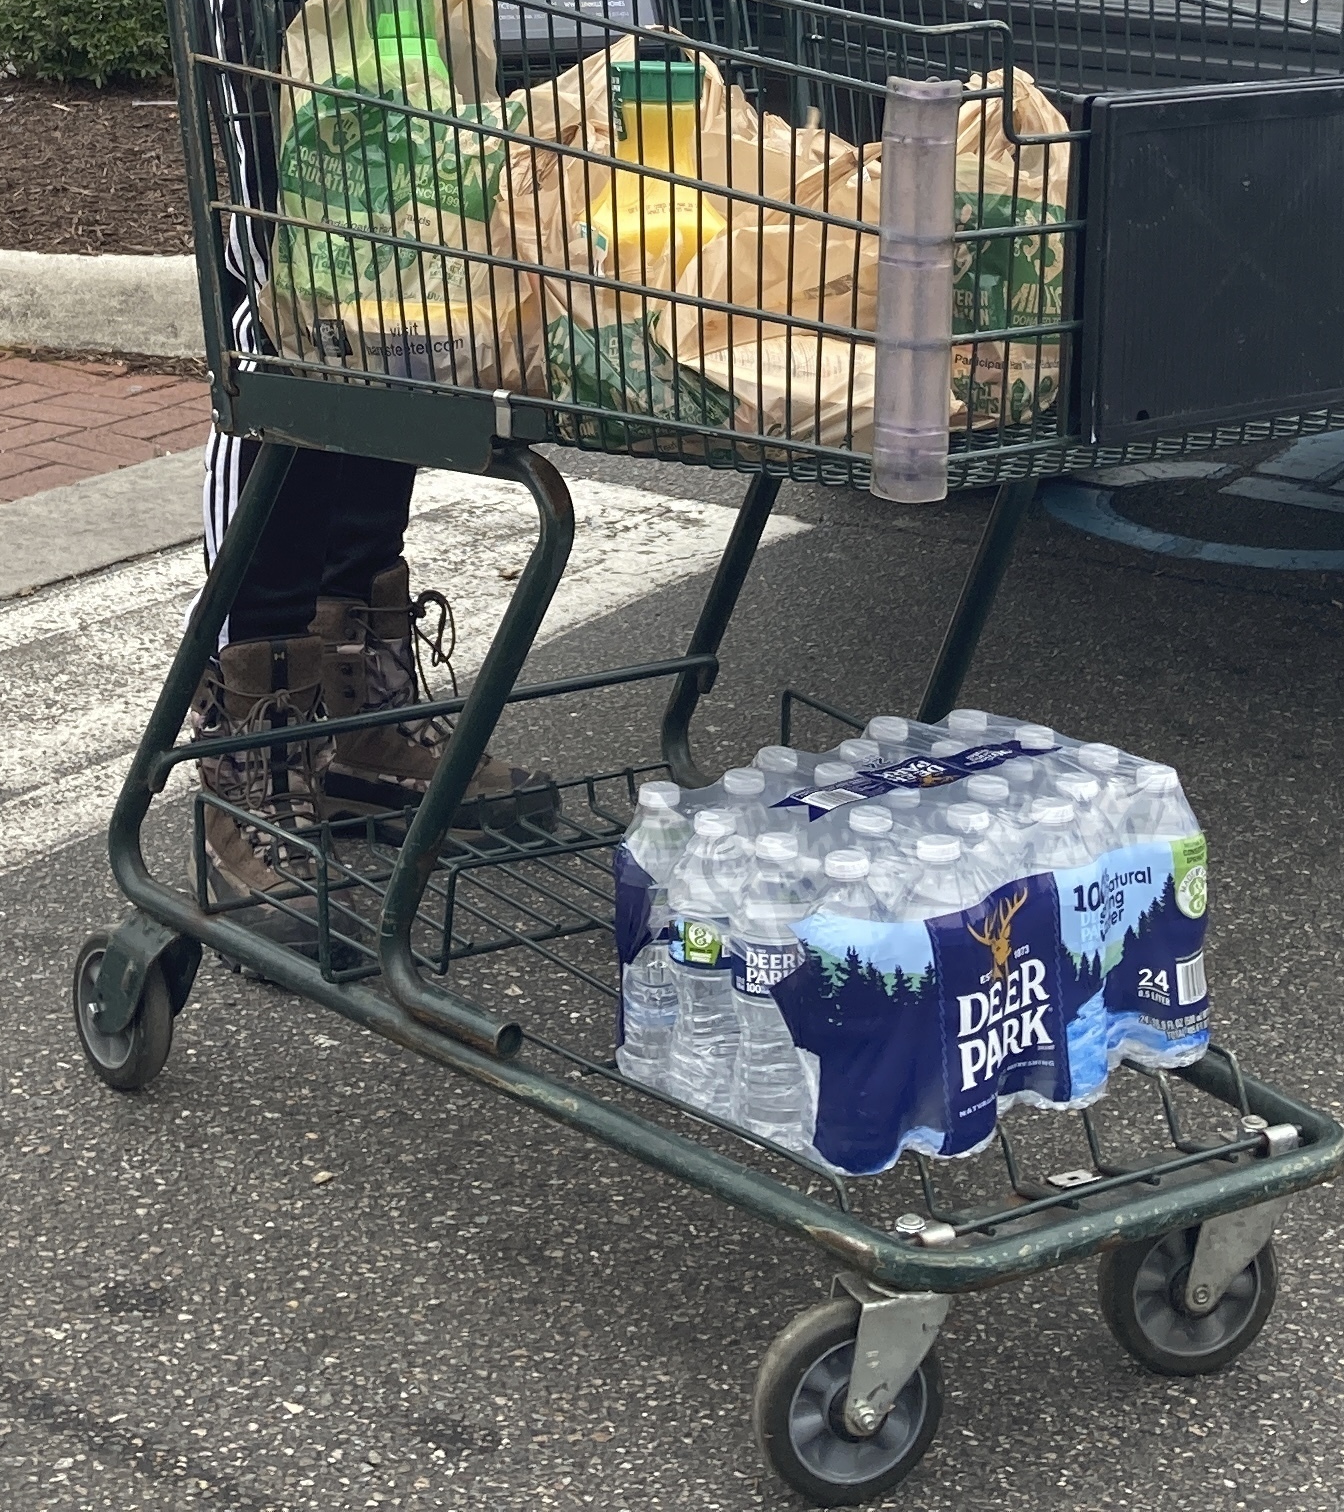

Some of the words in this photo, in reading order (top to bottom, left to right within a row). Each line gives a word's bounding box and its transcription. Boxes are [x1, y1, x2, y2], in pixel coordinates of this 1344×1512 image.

[746, 950, 796, 969] DEER
[1138, 968, 1170, 992] 24
[956, 958, 1050, 1038] DEER
[1137, 989, 1151, 999] 0.5
[1151, 991, 1171, 1006] LITER
[957, 1003, 1054, 1093] PARK
